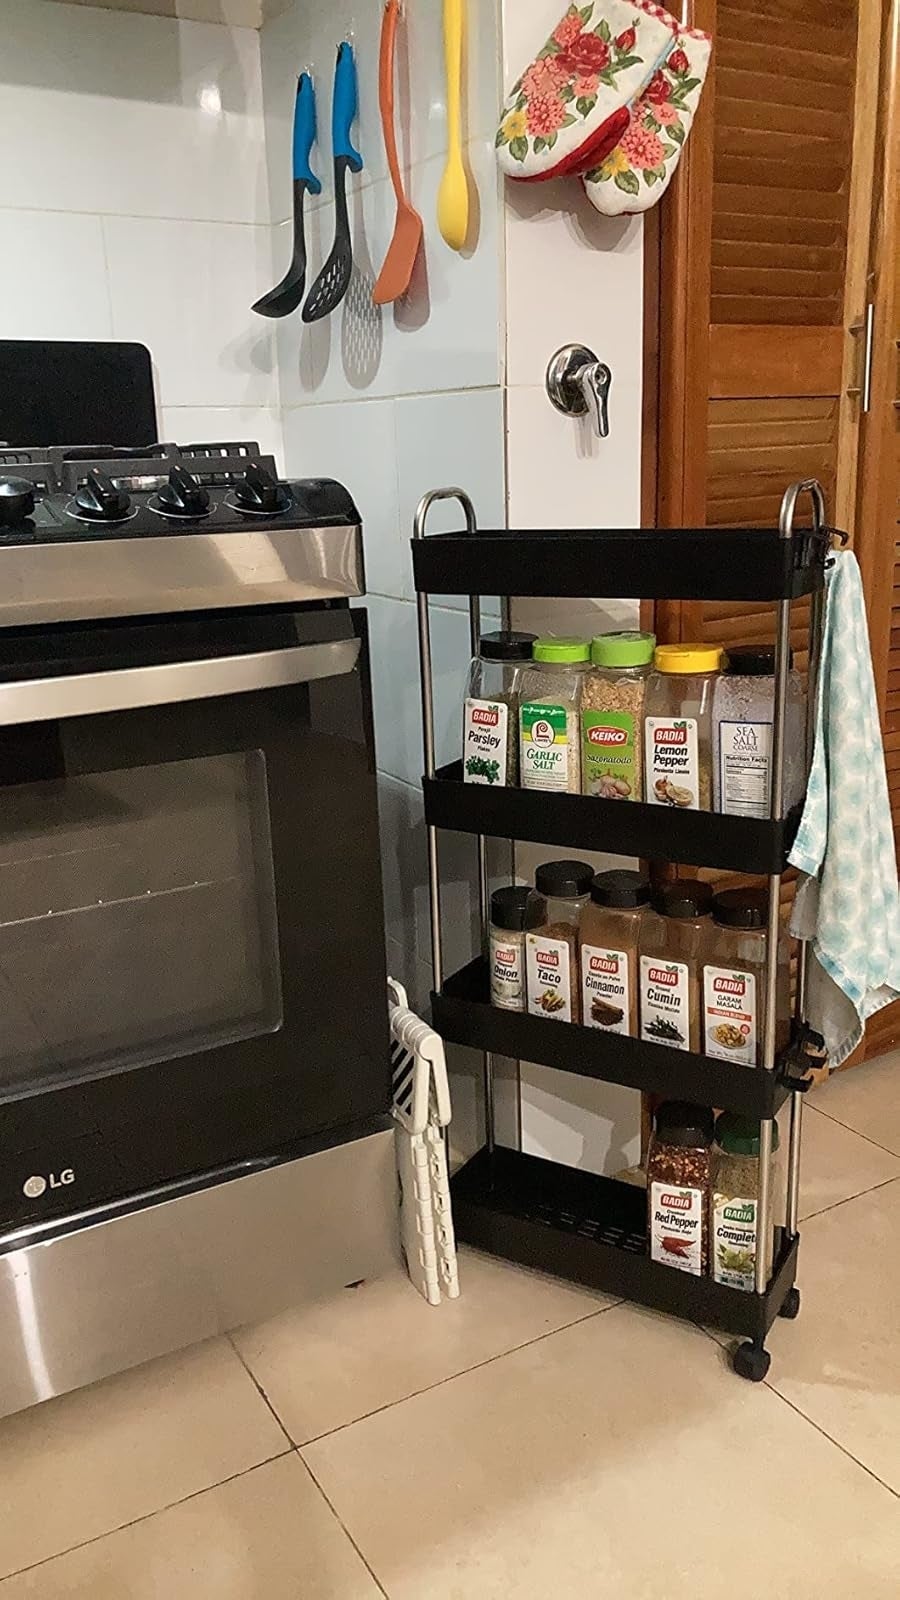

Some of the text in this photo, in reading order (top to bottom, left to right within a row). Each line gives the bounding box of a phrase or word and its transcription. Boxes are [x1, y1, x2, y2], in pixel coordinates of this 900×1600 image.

[473, 710, 497, 724] BADIA
[591, 731, 625, 742] KEIKO
[655, 730, 684, 742] BADIA
[736, 726, 756, 736] SEA
[468, 730, 501, 749] Parsley
[732, 736, 758, 746] SALT
[526, 748, 562, 761] GARLIC
[654, 744, 688, 756] Lemon
[732, 744, 758, 752] COARSE
[532, 760, 555, 770] SALT
[653, 755, 689, 767] Pepper
[537, 953, 558, 965] BADIA
[591, 958, 617, 972] BADIA
[494, 964, 518, 978] Onion
[537, 968, 561, 984] Taco
[649, 969, 676, 984] BADIA
[585, 976, 625, 995] Cinnamon
[715, 979, 743, 993] BADIA
[646, 987, 681, 1007] Cumin
[717, 994, 742, 1004] GARAM
[716, 1000, 743, 1010] MASALA
[49, 1168, 76, 1189] LG
[662, 1195, 690, 1208] BADIA
[654, 1211, 699, 1229] Red Pepper
[725, 1208, 752, 1221] BADIA
[716, 1227, 756, 1243] Complet
